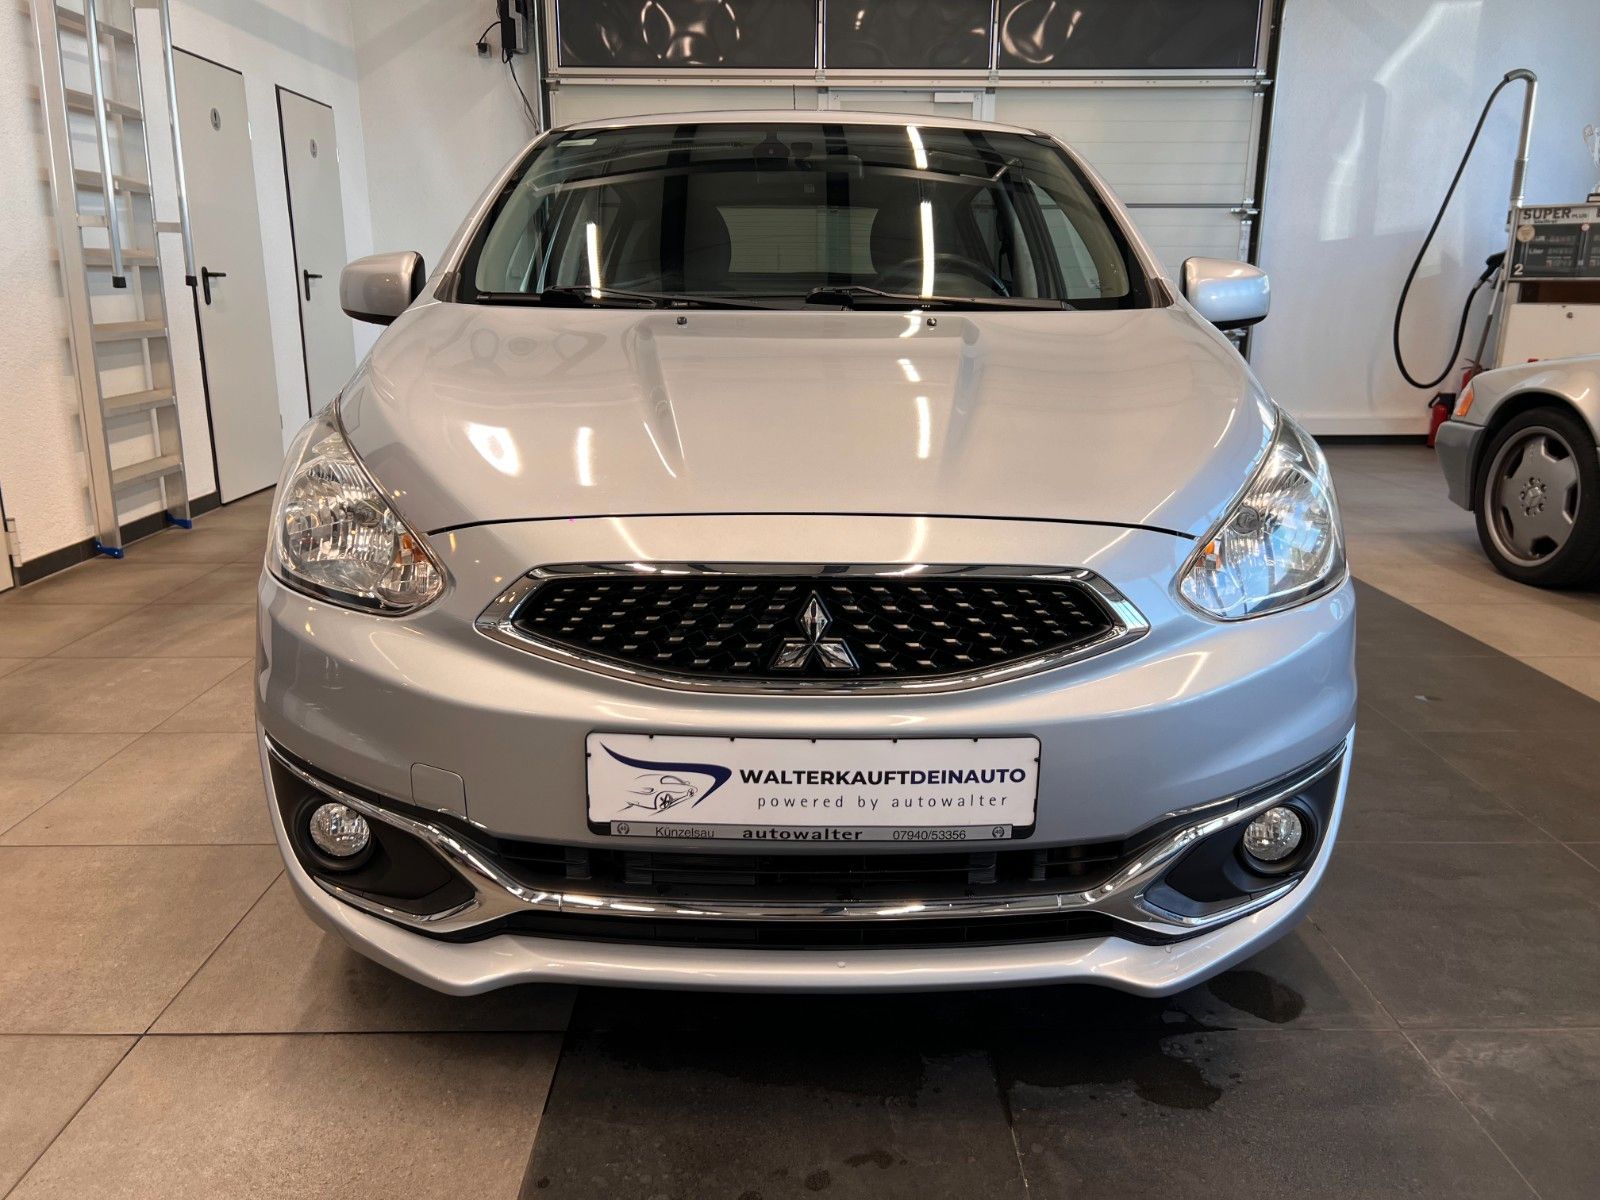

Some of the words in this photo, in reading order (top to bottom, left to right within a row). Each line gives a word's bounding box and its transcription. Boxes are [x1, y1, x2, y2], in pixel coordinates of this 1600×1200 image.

[1523, 208, 1571, 220] SUPER
[1513, 263, 1524, 276] 2
[739, 768, 1026, 786] WALTERKAUFTDEINAUTO
[758, 795, 844, 810] powered
[857, 795, 879, 811] by
[891, 794, 1008, 808] autowalter
[655, 826, 715, 839] Künzelsau
[742, 828, 863, 840] autowalter
[892, 829, 967, 840] 07940/53356
